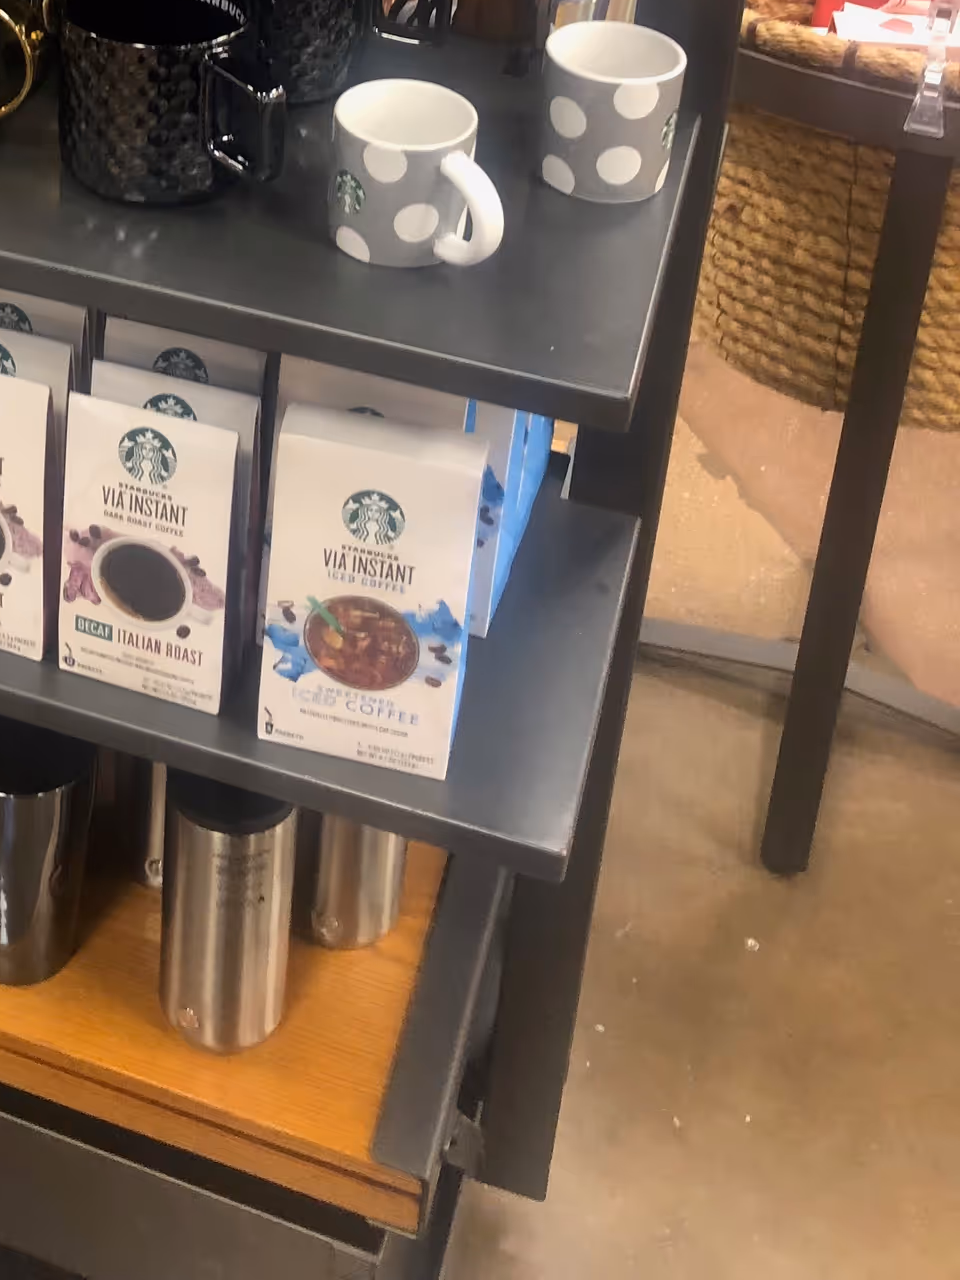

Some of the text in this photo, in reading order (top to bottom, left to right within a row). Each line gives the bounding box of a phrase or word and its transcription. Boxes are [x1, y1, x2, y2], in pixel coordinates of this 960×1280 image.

[102, 485, 188, 527] VIA INSTANT
[118, 482, 173, 501] STARBUCKS
[103, 509, 184, 538] DARK ROAST COFFEE
[323, 547, 416, 585] VIA INSTANT
[341, 544, 399, 561] STARBUCKS
[328, 570, 405, 594] ICED COFFEE
[77, 617, 111, 639] DECAF
[117, 628, 161, 655] ITALIAN
[166, 641, 203, 667] ROAST
[292, 687, 337, 707] ICED
[345, 700, 420, 726] COFFEE
[317, 685, 394, 707] SWEETENED
